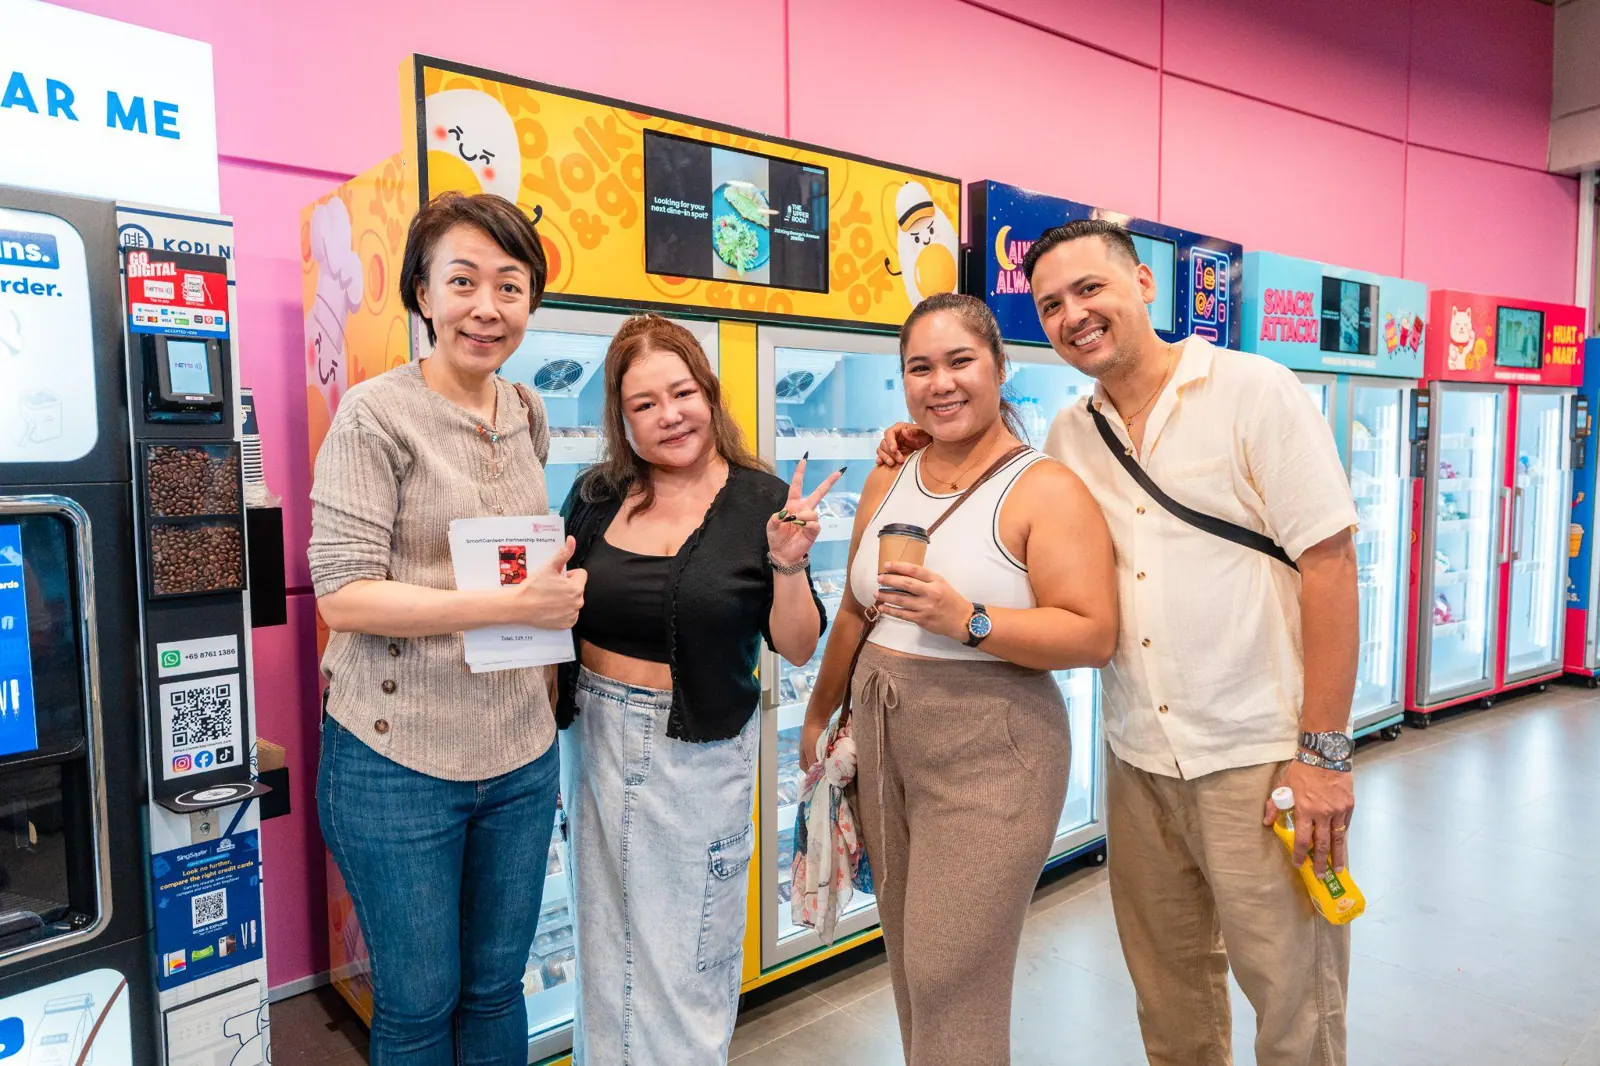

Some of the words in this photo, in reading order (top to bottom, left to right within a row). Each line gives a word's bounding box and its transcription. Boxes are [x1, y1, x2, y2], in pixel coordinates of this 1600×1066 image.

[0, 72, 79, 121] AR
[107, 90, 180, 140] ME
[523, 114, 634, 212] Yolk
[654, 197, 679, 209] Looking
[667, 206, 690, 216] dine-in
[691, 211, 708, 219] spot?
[793, 210, 809, 218] UPPER
[569, 208, 609, 249] &
[0, 241, 50, 262] ns.
[129, 252, 148, 264] GO
[219, 245, 235, 259] N
[128, 262, 176, 278] DIGITAL
[1, 277, 62, 297] rder.
[996, 271, 1031, 294] ALWA
[1264, 289, 1314, 316] SNACK
[1260, 316, 1318, 343] ATTACK!
[1553, 325, 1577, 344] HUAT
[1552, 346, 1577, 365] MART
[160, 879, 188, 890] compare
[201, 870, 217, 879] right
[218, 865, 236, 874] credit
[237, 861, 254, 869] cards
[182, 867, 198, 876] Look
[209, 860, 232, 869] further,
